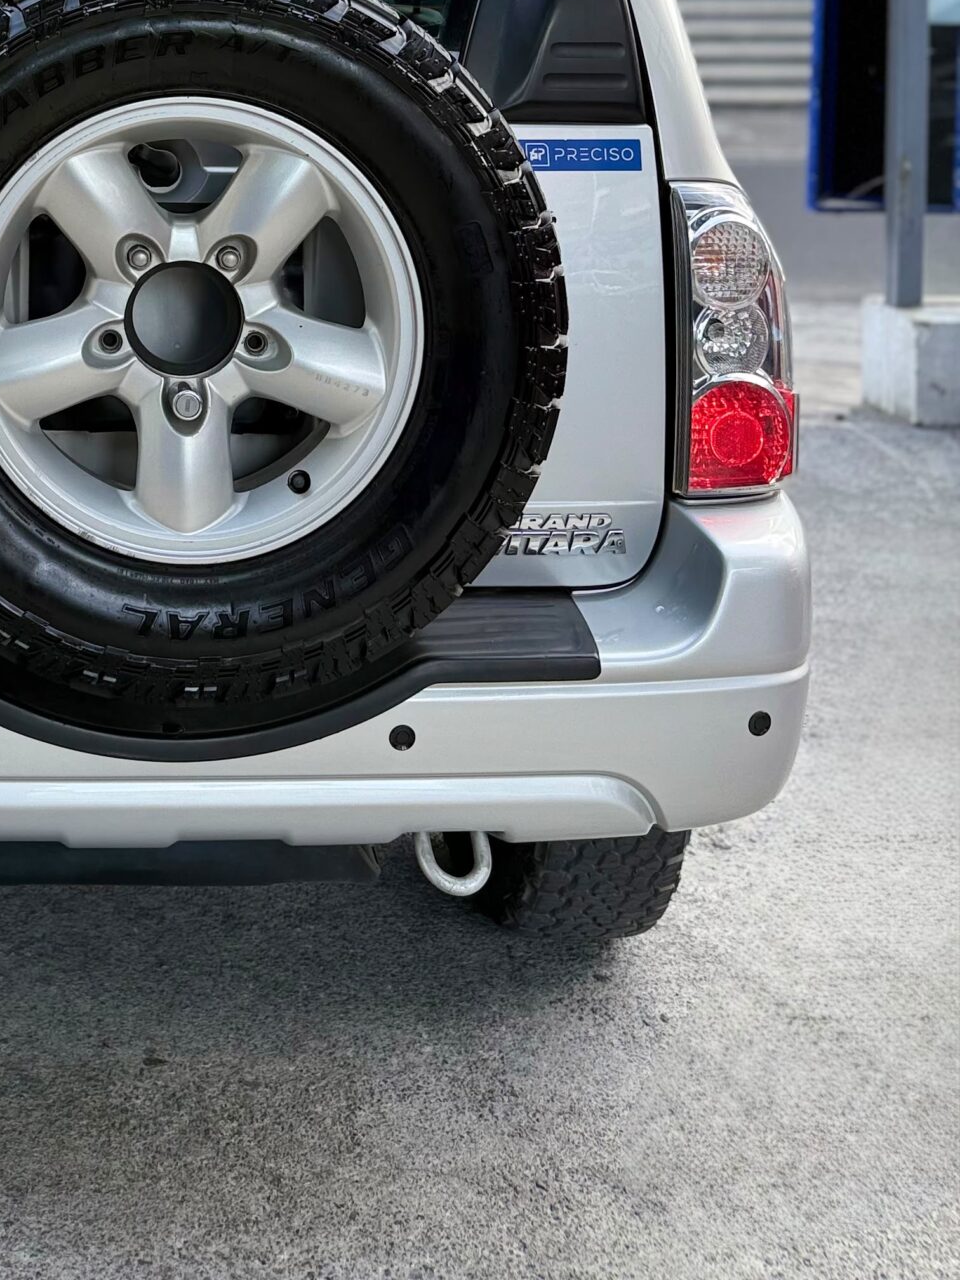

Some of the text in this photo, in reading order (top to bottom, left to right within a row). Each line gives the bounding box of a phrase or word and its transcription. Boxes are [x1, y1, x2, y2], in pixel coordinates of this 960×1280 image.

[554, 147, 634, 161] PRECISO
[509, 512, 612, 531] RAND
[497, 529, 627, 556] ITARA
[120, 524, 414, 642] GENERAL
